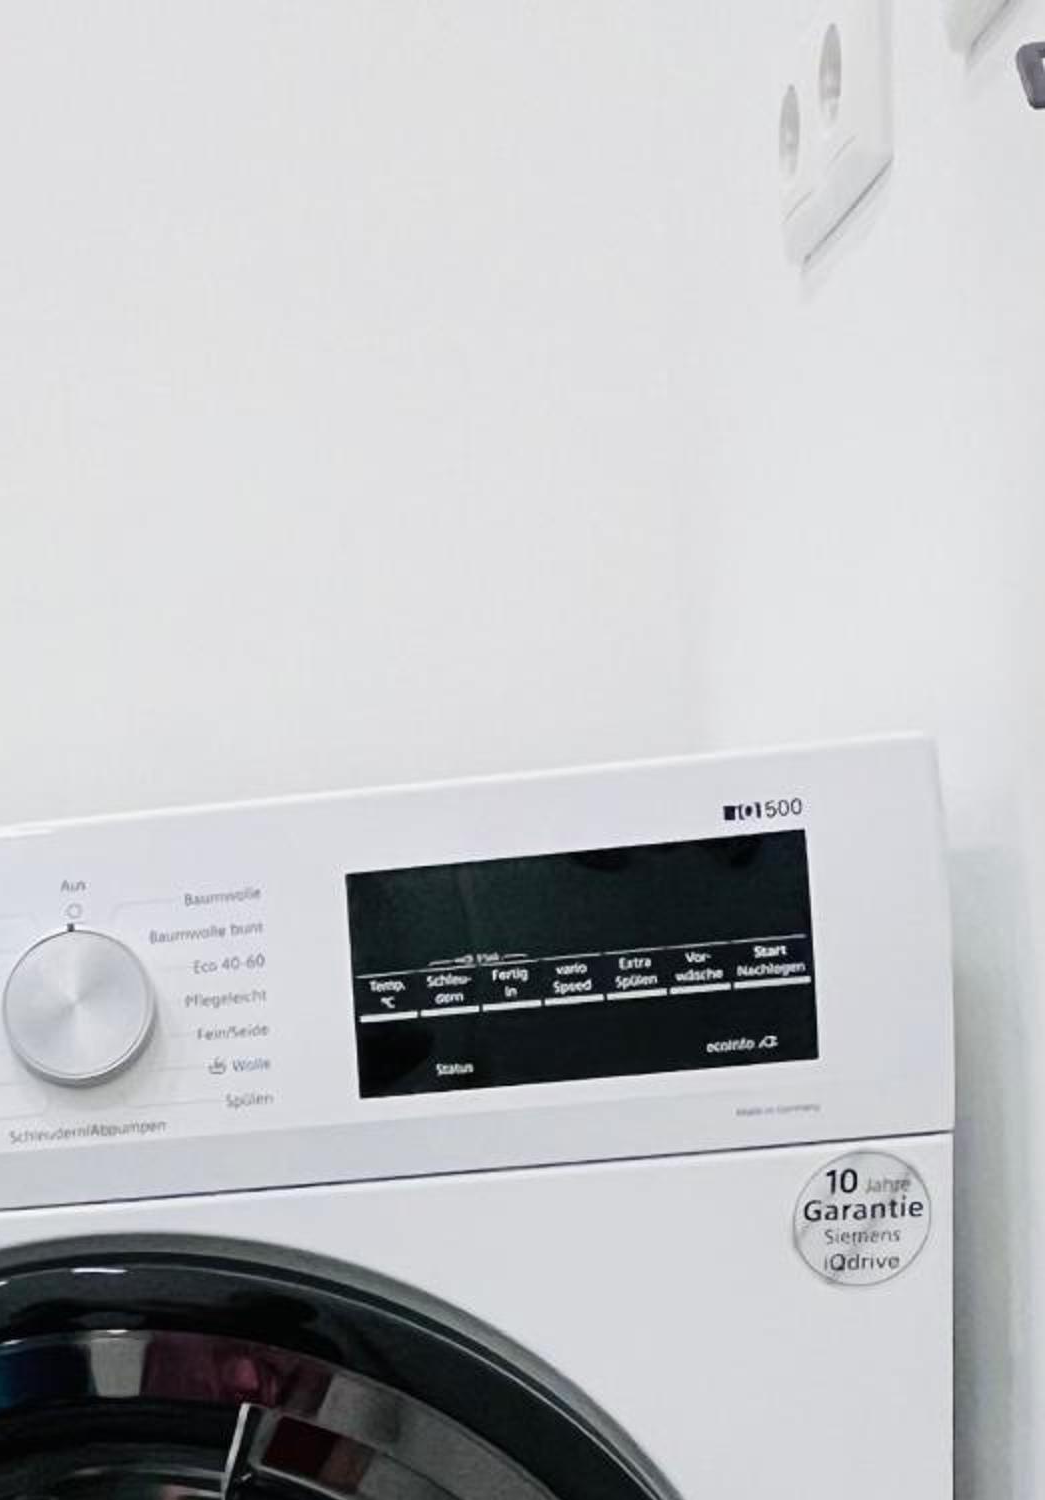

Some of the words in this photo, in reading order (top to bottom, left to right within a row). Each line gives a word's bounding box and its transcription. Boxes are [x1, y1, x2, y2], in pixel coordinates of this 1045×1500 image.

[60, 879, 86, 893] Aus
[183, 887, 261, 907] Baumwolle
[149, 924, 226, 944] Baumwolle
[229, 921, 263, 937] bunt
[685, 951, 712, 964] Vor-
[754, 944, 787, 959] Start
[193, 959, 218, 975] Eco
[221, 952, 266, 971] 40-60
[556, 963, 588, 976] vario
[618, 956, 652, 971] Extra
[736, 962, 806, 979] Nachlegen
[426, 973, 472, 988] Schleu-
[492, 968, 529, 983] Fertig
[615, 973, 658, 991] Spülen
[675, 967, 723, 982] wäsche
[553, 979, 592, 995] Speed
[184, 989, 267, 1009] Pflegeleicht
[197, 1025, 269, 1041] Fein/Seide
[232, 1056, 271, 1072] Wolle
[436, 1062, 474, 1077] Status
[225, 1092, 274, 1110] Spülen
[826, 1168, 858, 1195] 10
[864, 1175, 911, 1195] Jahre
[803, 1195, 924, 1222] Garantie
[824, 1228, 901, 1245] Siemens
[824, 1253, 901, 1272] iQdrive
